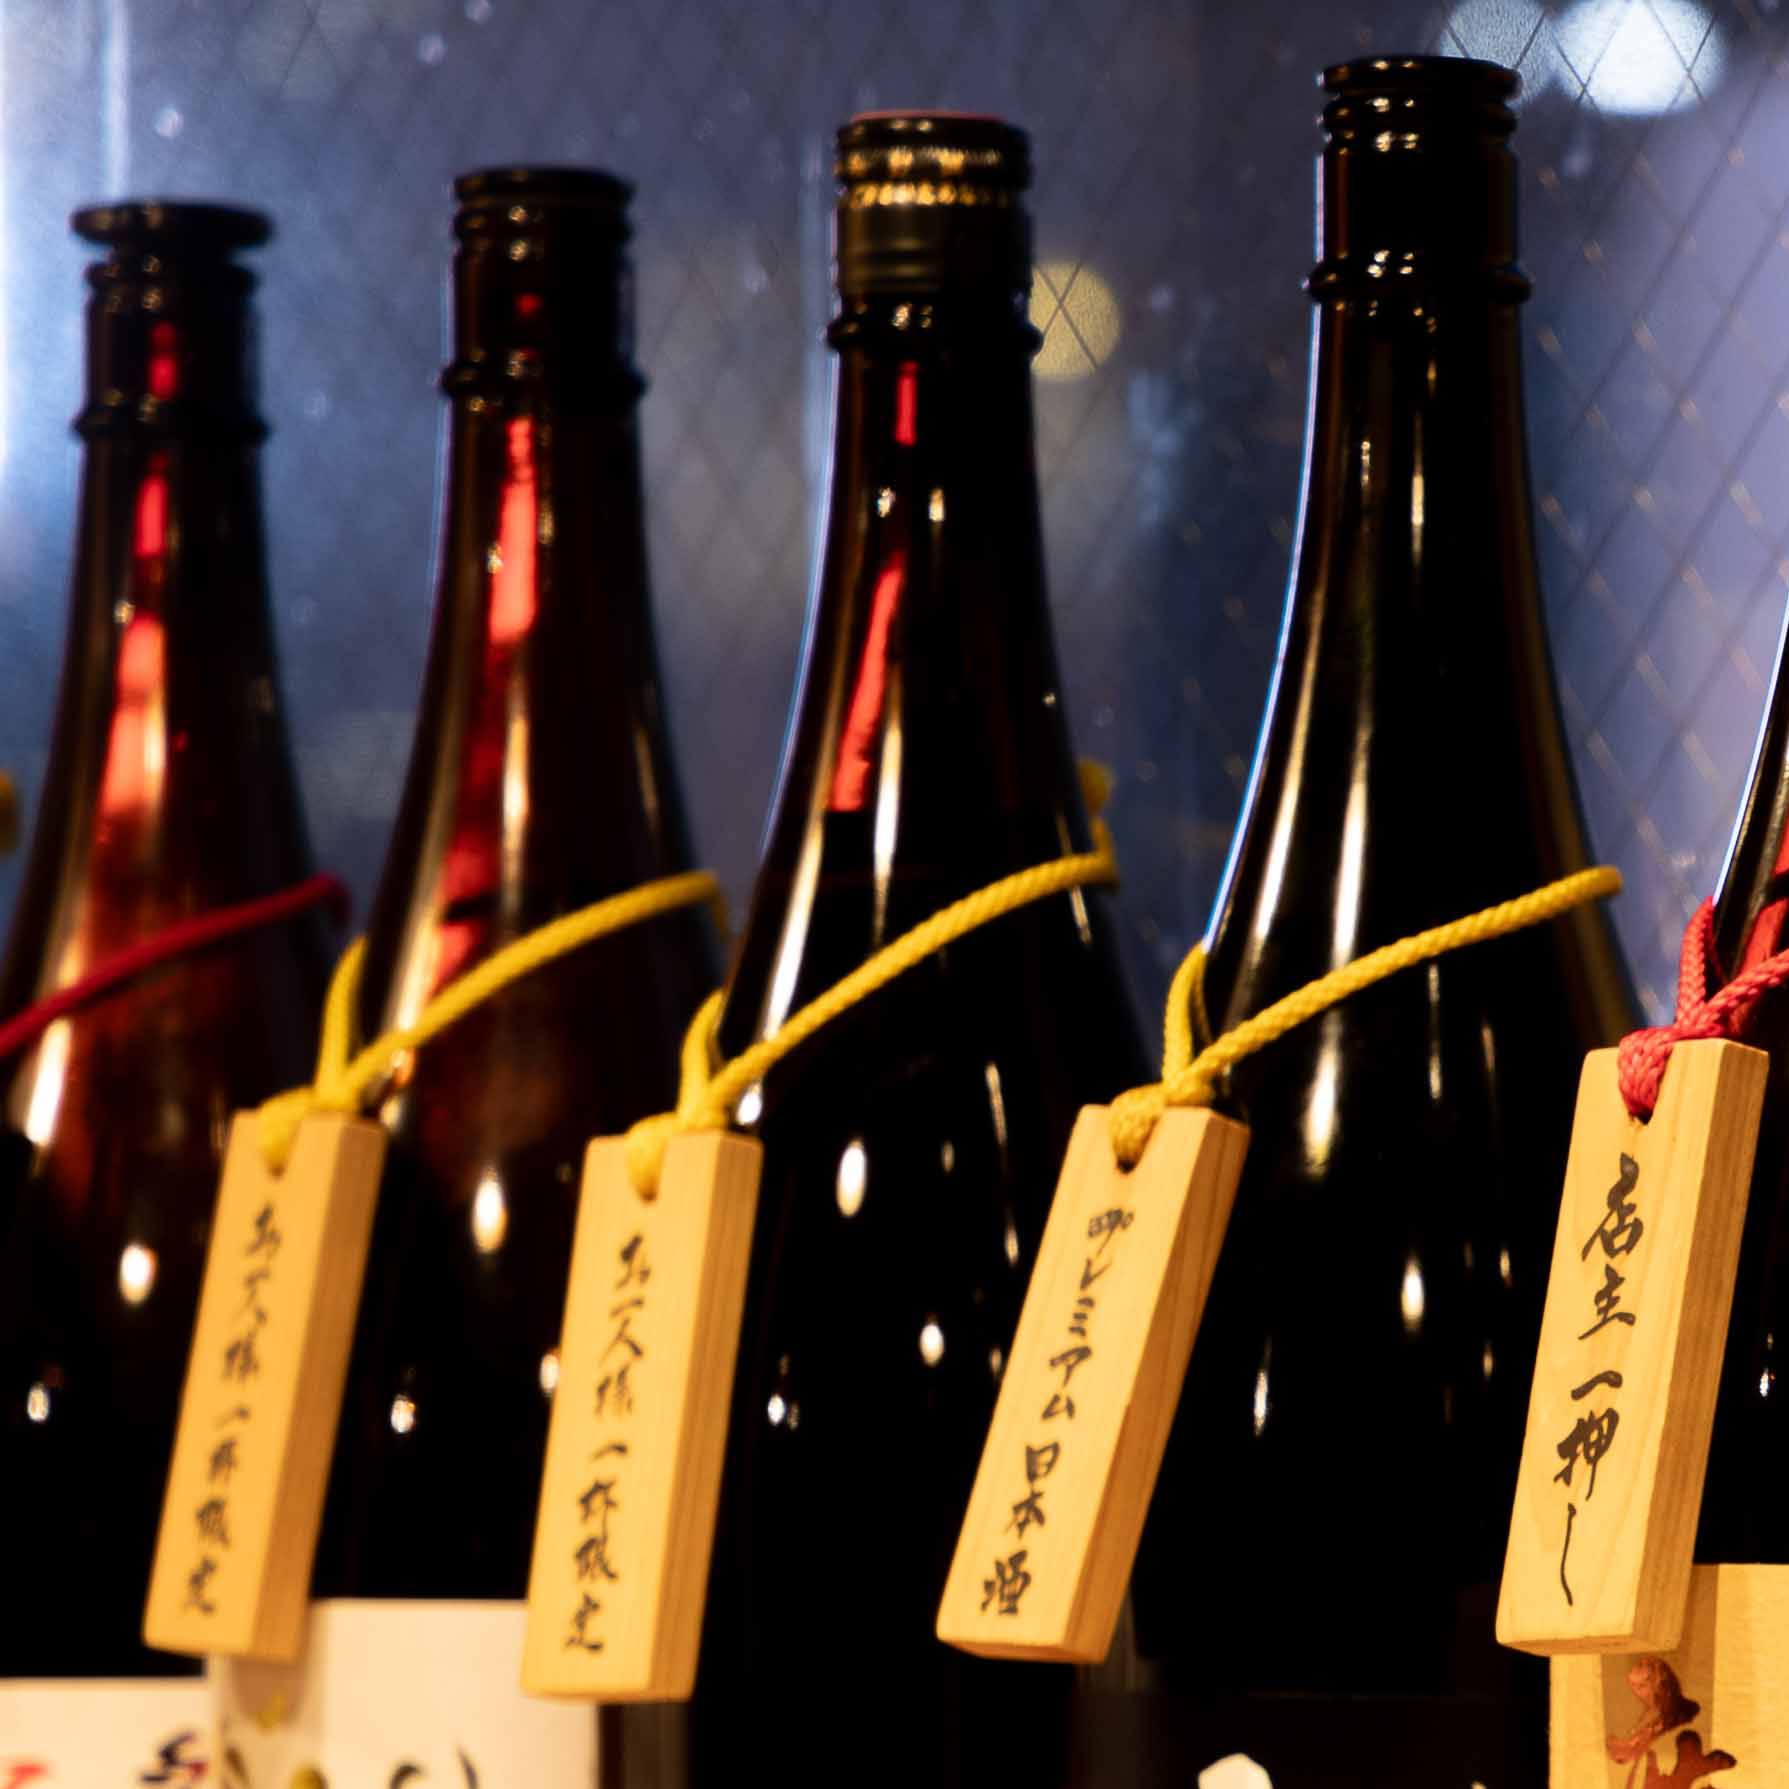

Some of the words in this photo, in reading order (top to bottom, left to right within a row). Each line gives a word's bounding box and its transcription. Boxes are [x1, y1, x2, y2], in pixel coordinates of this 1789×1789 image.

[565, 1235, 651, 1652] お一人様一杯限定
[980, 1208, 1134, 1616] プレミアム日本酒
[1553, 1152, 1645, 1606] 店主一押し
